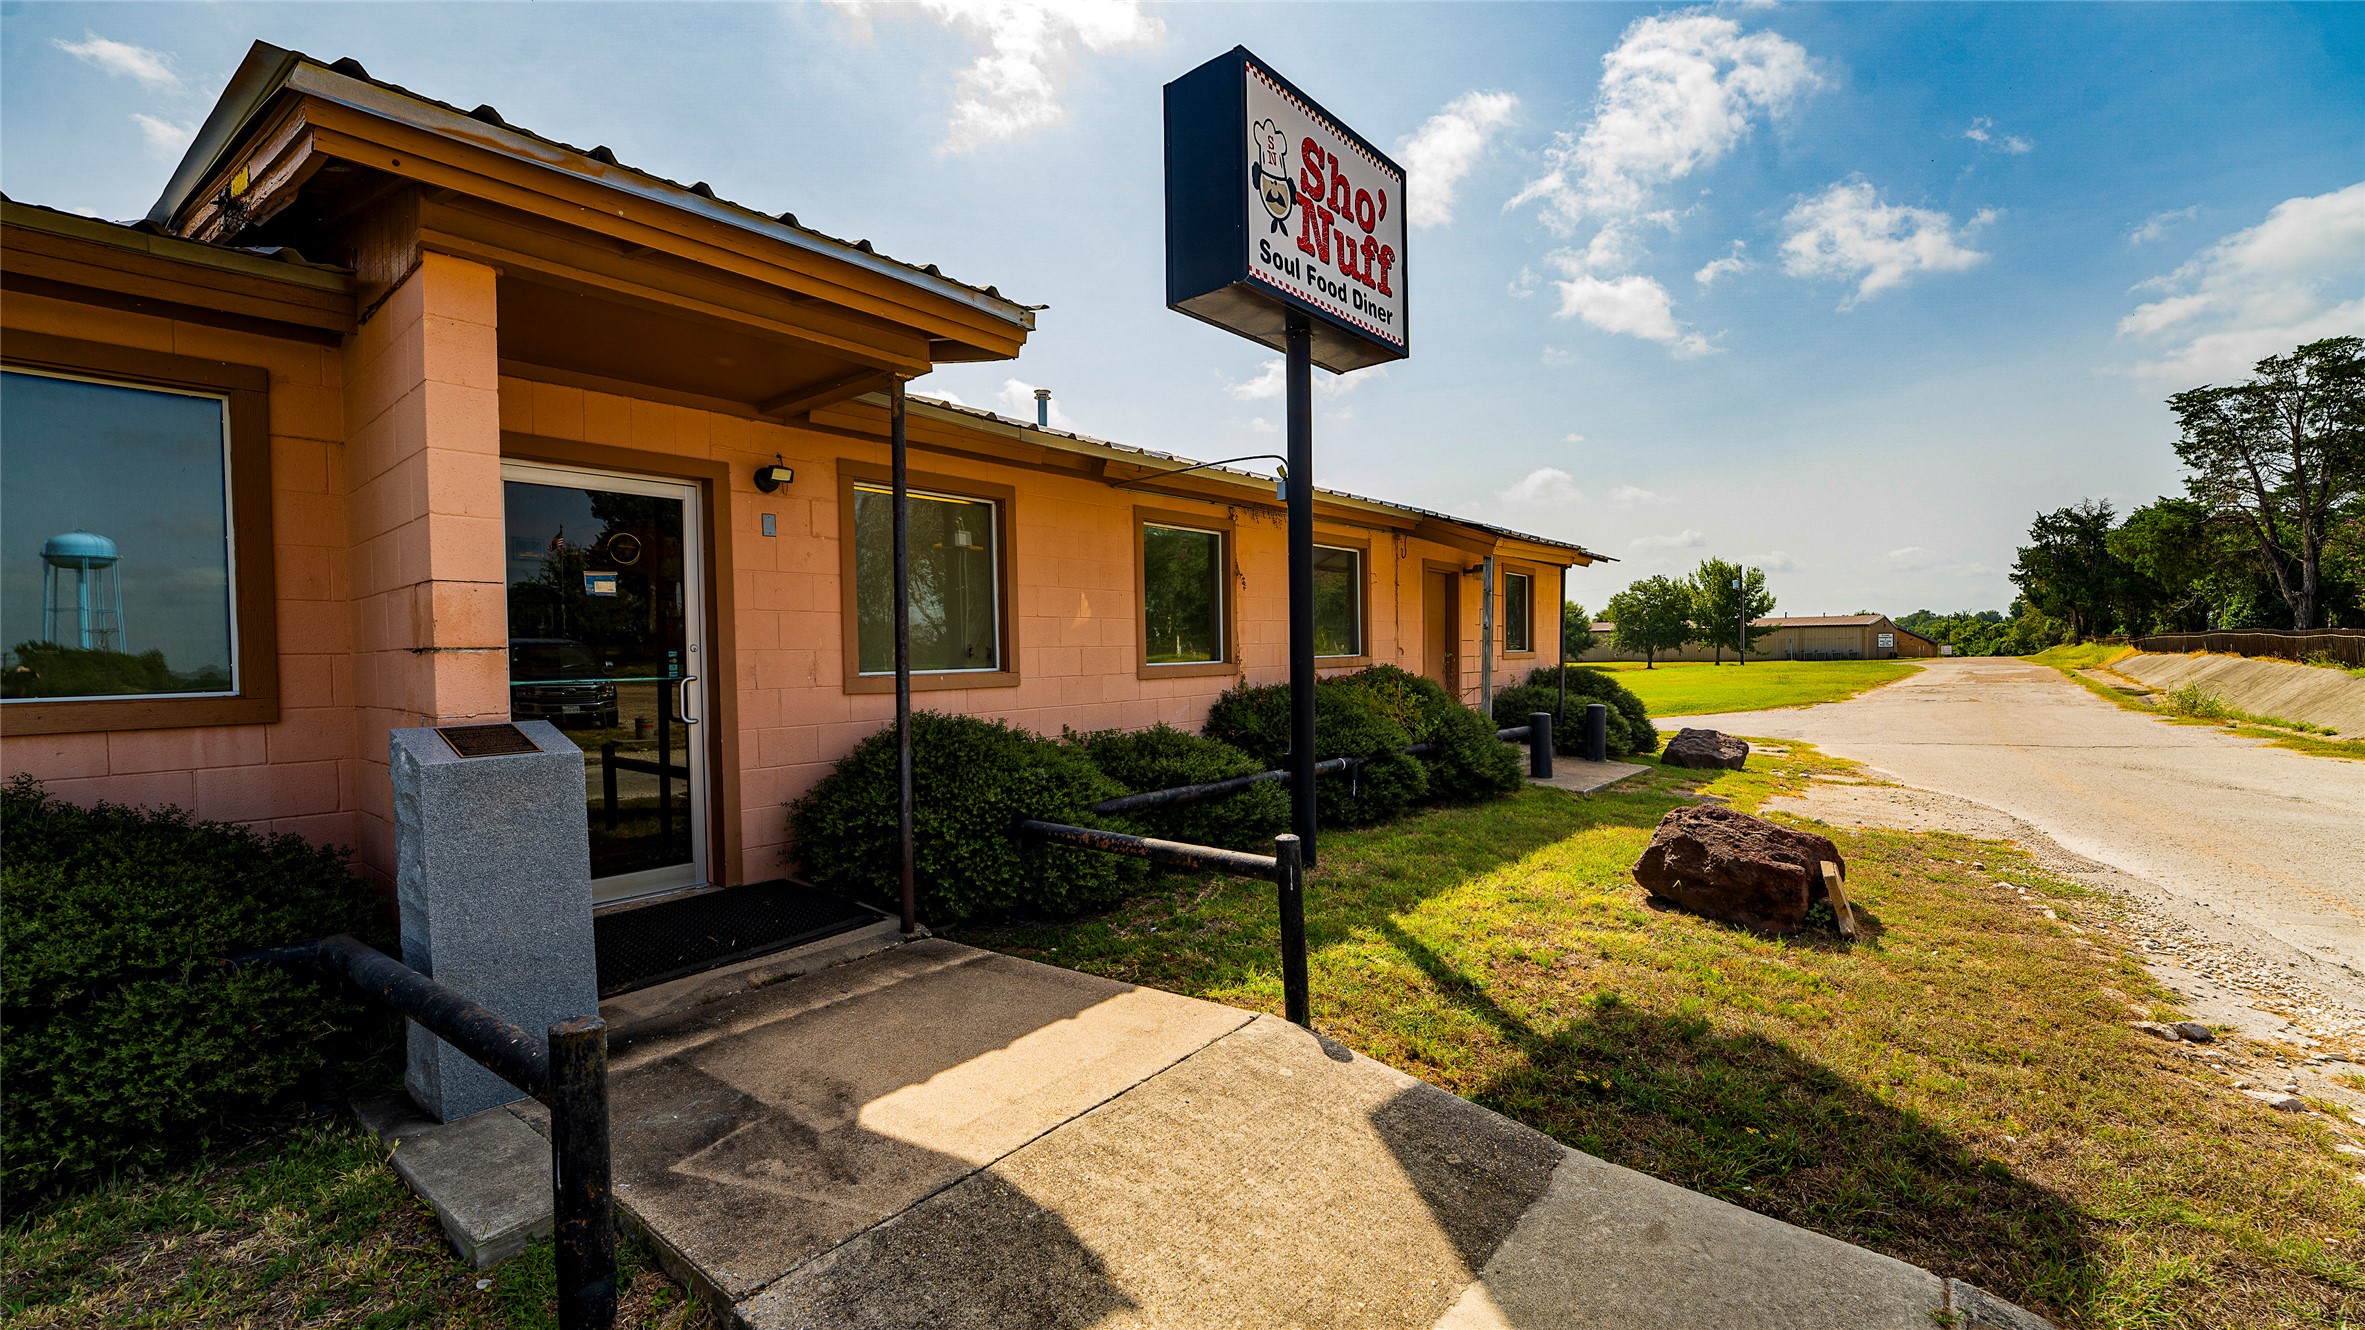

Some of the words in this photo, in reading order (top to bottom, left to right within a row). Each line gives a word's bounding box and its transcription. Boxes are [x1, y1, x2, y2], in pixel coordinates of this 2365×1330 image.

[1267, 135, 1275, 150] S
[1267, 150, 1277, 166] N
[1295, 191, 1396, 298] Nuff
[1259, 238, 1301, 280] Soul
[1306, 266, 1347, 304] Food
[1352, 289, 1393, 325] Diner
